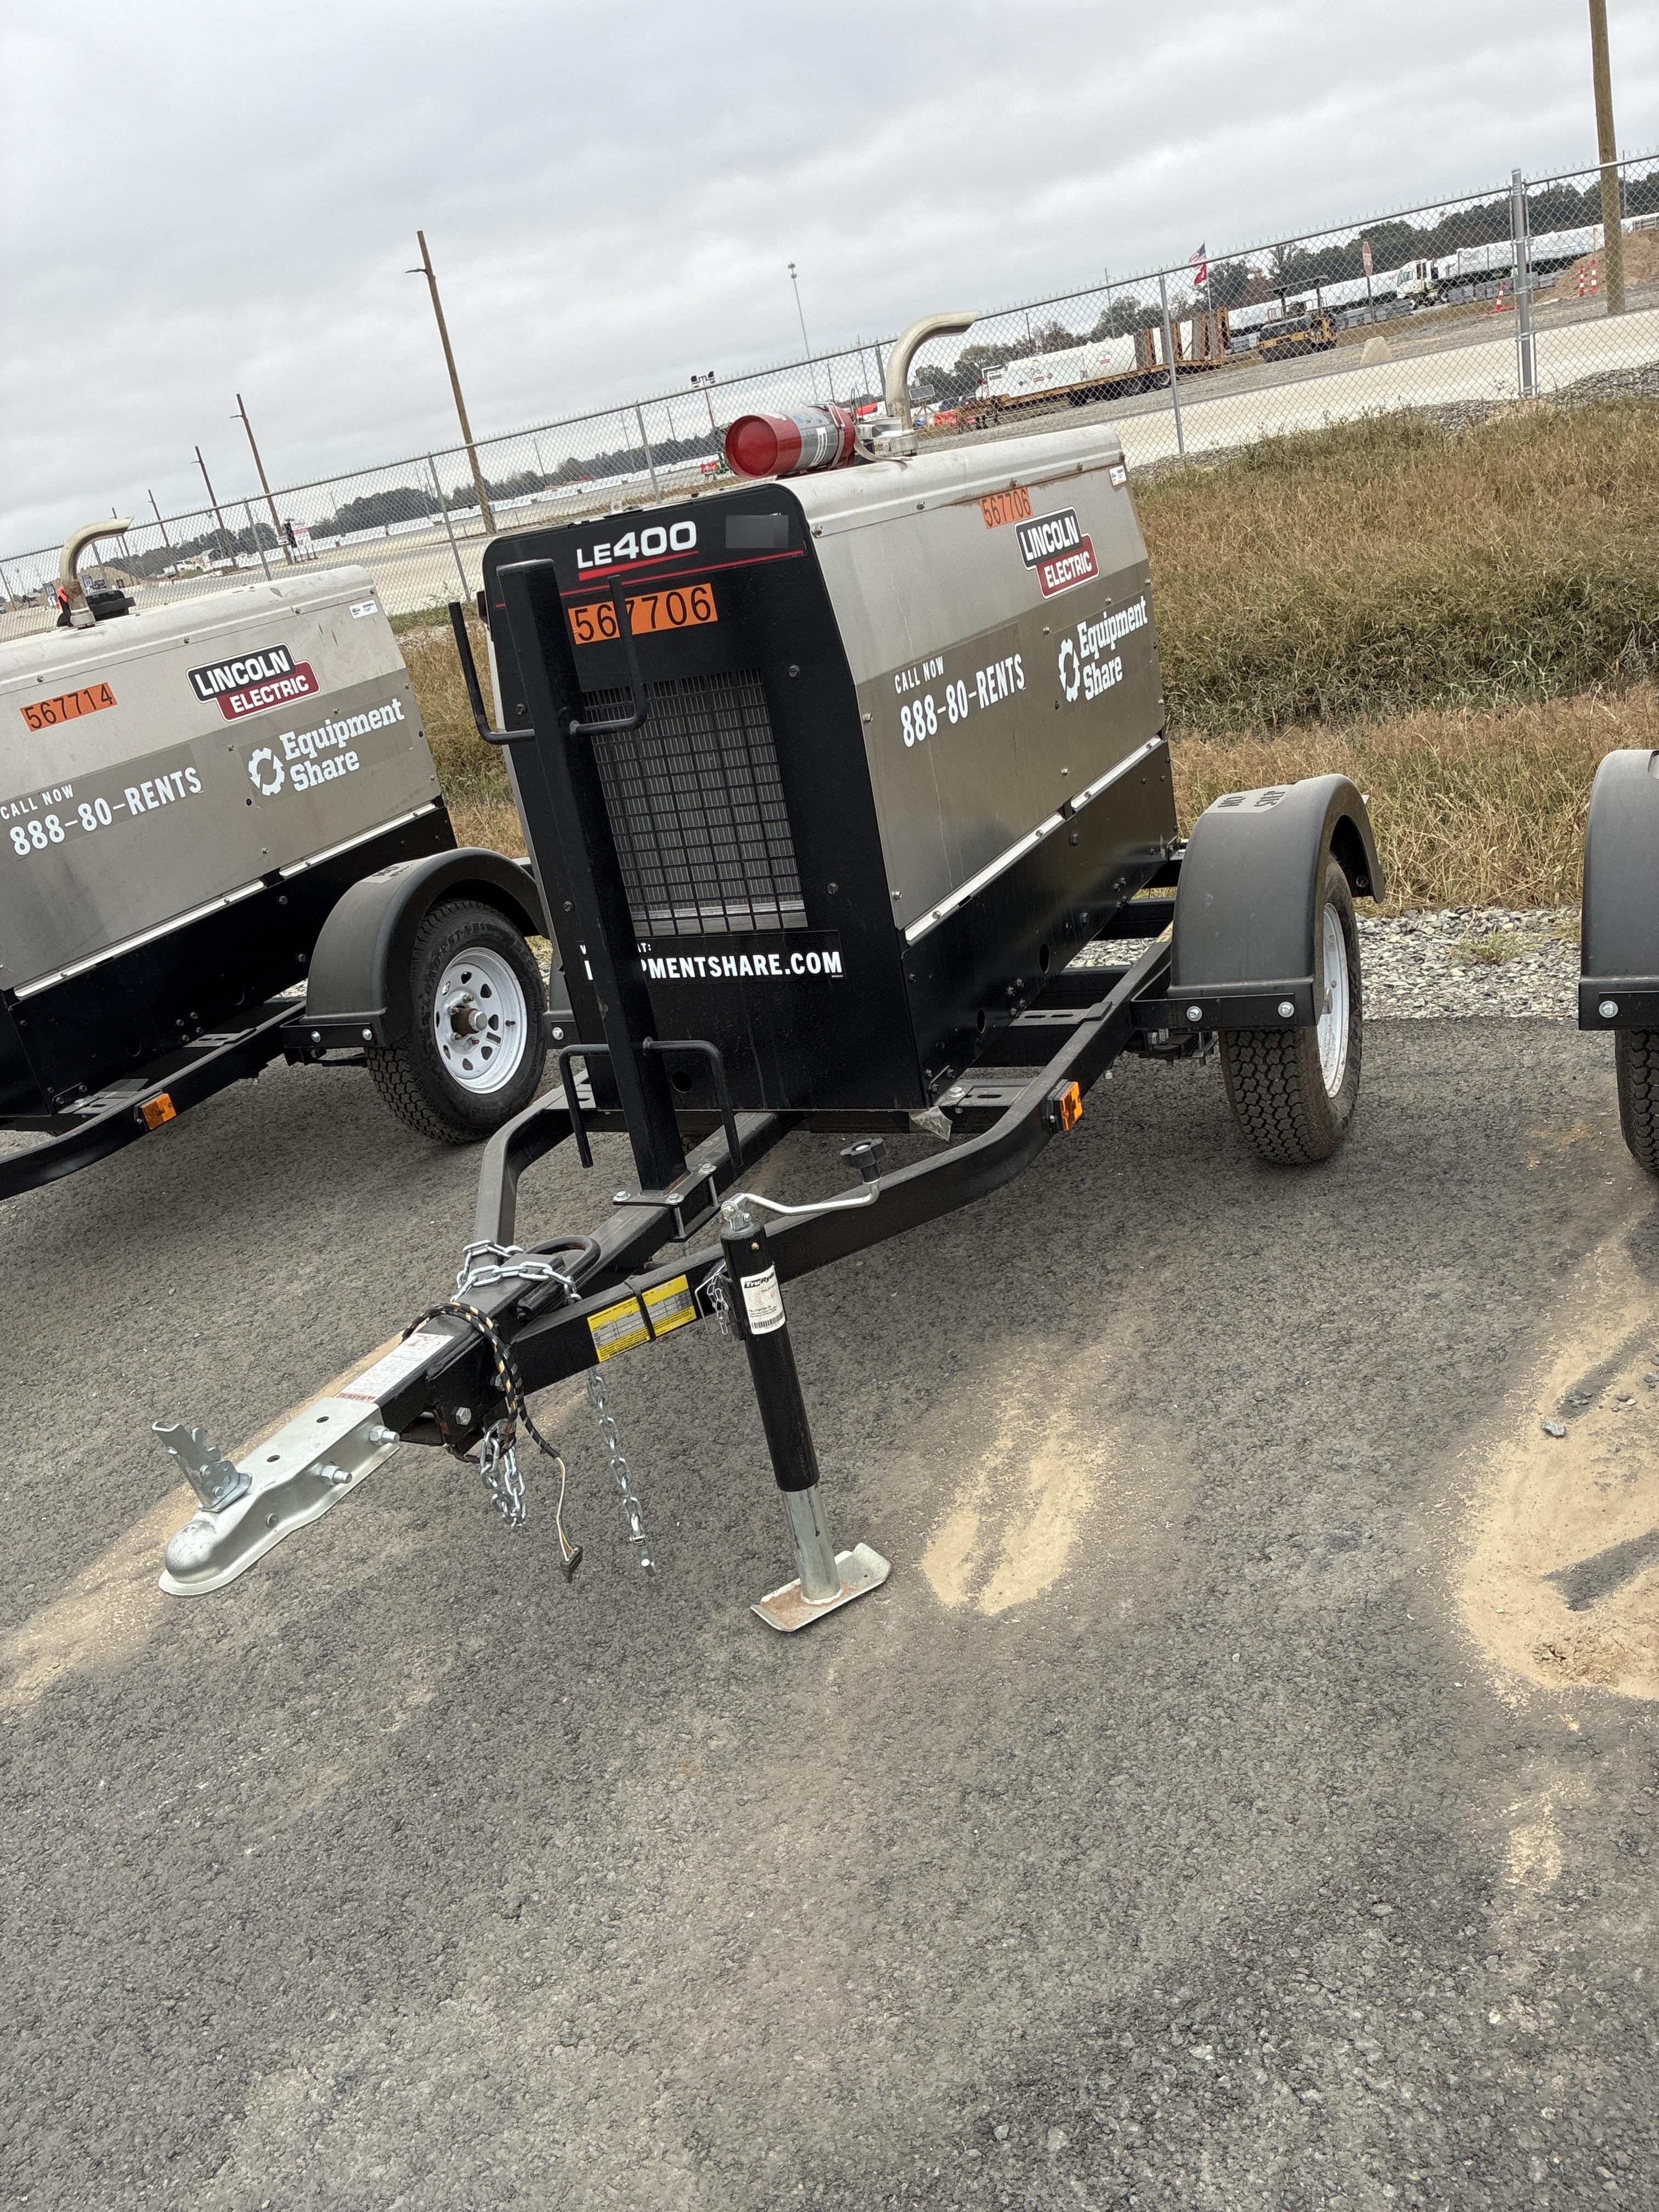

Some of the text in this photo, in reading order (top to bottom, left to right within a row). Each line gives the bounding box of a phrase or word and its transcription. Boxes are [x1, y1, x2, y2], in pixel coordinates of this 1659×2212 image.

[982, 488, 1031, 527] 567706
[577, 521, 697, 569] LE400
[1020, 516, 1080, 561] LINCOLN
[1043, 551, 1092, 589] ELECTRIC
[574, 587, 711, 641] 567706
[1077, 595, 1148, 660] Equipment
[194, 650, 291, 696] LINCOLN
[229, 675, 309, 713] ELECTRIC
[895, 656, 944, 694] CALL NOW
[1083, 656, 1123, 701] Share
[25, 684, 112, 729] 567714
[901, 653, 1024, 747] 888-80-RENTS
[279, 698, 405, 761] Equipment
[290, 751, 359, 792] Share
[0, 785, 74, 820] CALL NOW
[10, 767, 202, 856] 888-80-RENTS
